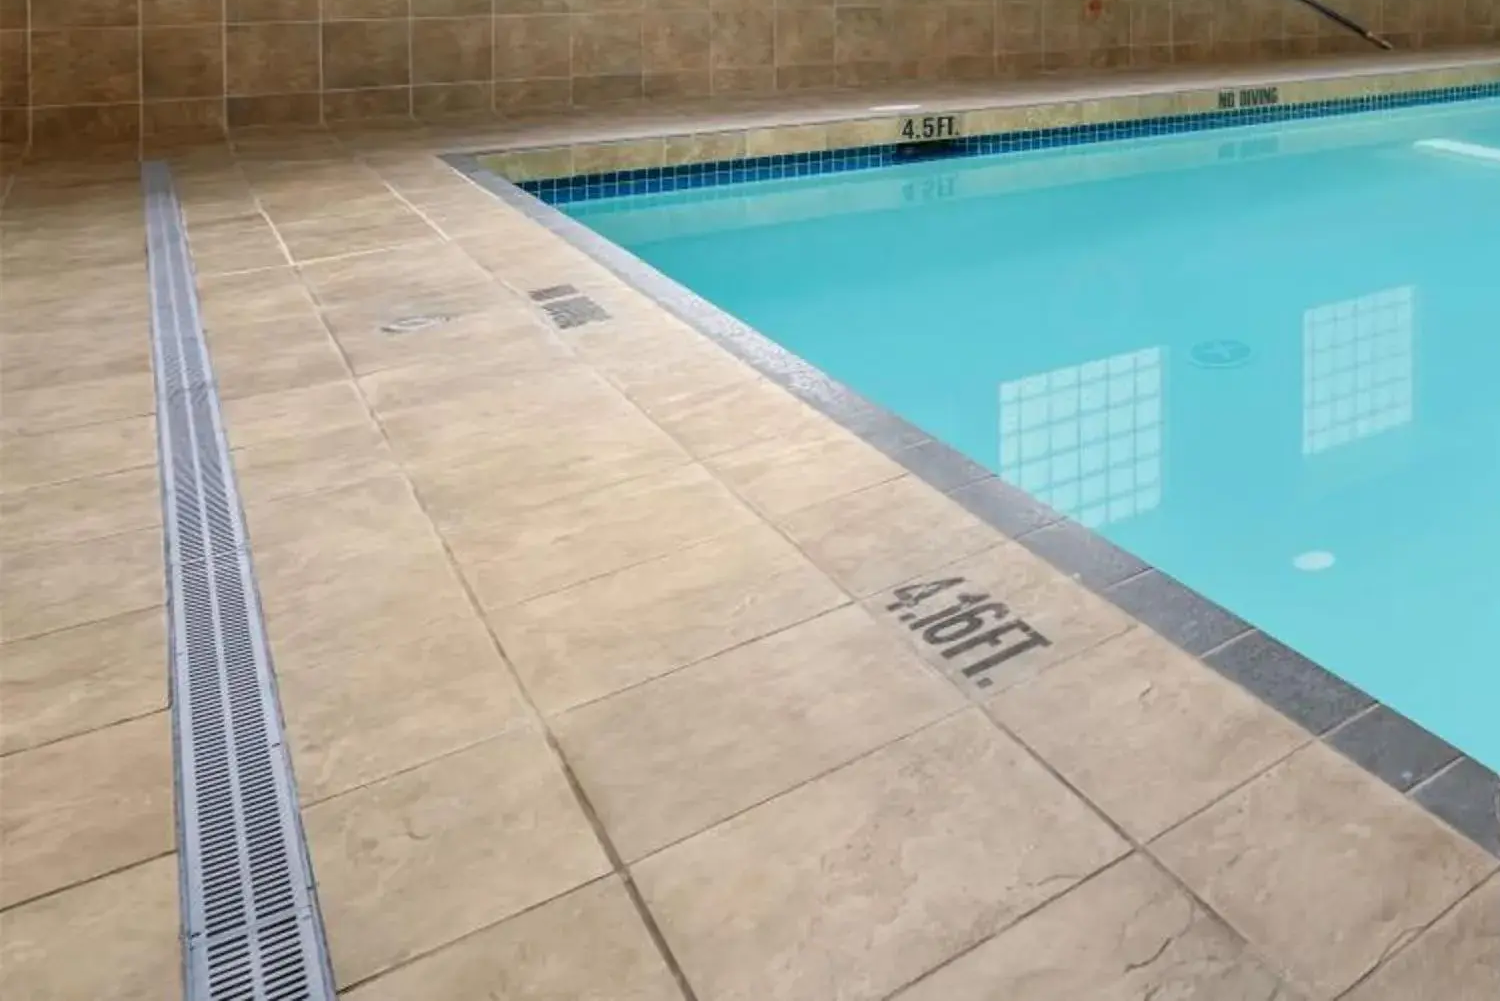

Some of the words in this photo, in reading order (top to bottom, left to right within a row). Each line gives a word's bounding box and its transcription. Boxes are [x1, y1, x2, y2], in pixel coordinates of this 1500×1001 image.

[1218, 90, 1235, 108] NO
[1239, 86, 1279, 106] DIVING
[886, 577, 1053, 688] 4.16FT.
